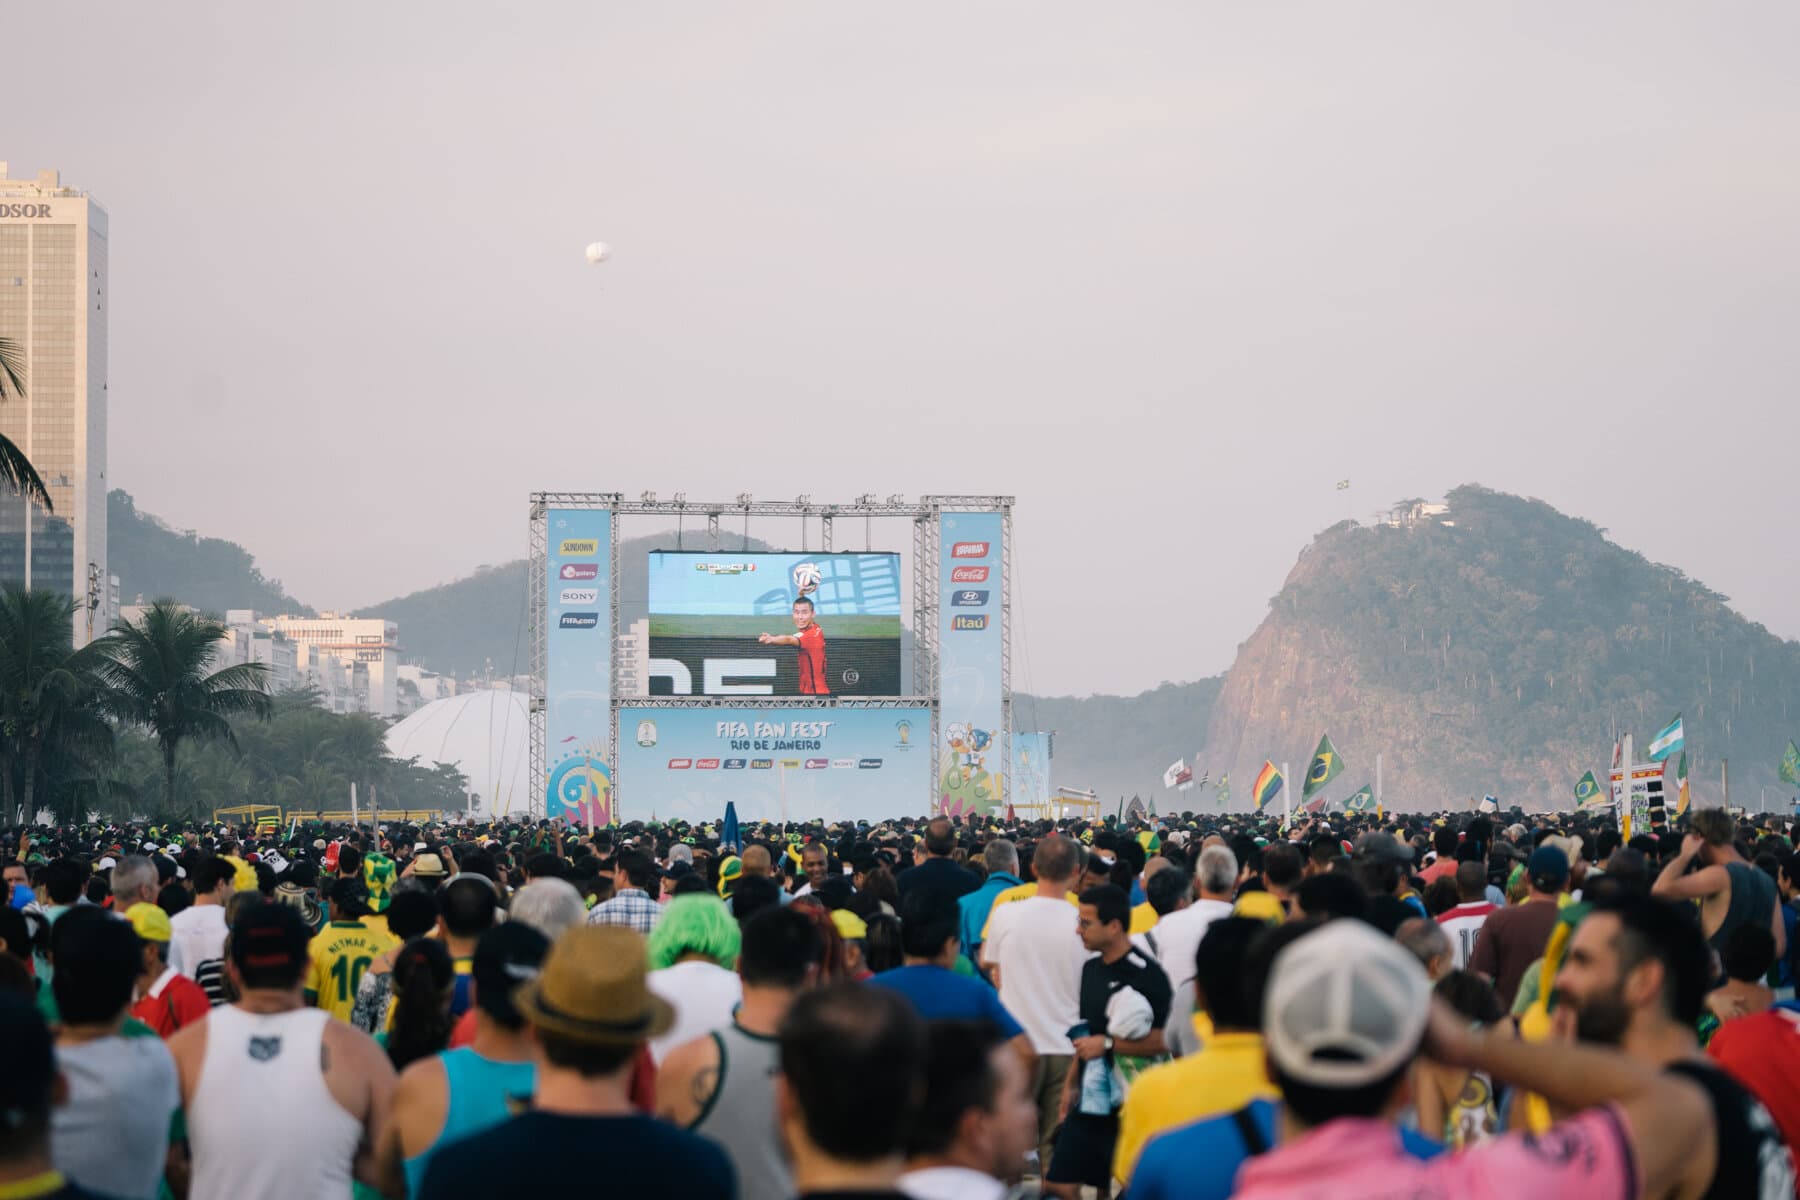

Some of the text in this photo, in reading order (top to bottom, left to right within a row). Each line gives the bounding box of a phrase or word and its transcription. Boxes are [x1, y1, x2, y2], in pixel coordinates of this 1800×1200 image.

[563, 543, 593, 552] SUNDOWN
[957, 617, 984, 628] Itaú
[716, 721, 833, 738] FIFA FAN FEST
[730, 740, 821, 750] RIO DE JANEIRO
[328, 937, 366, 953] NEYMAR
